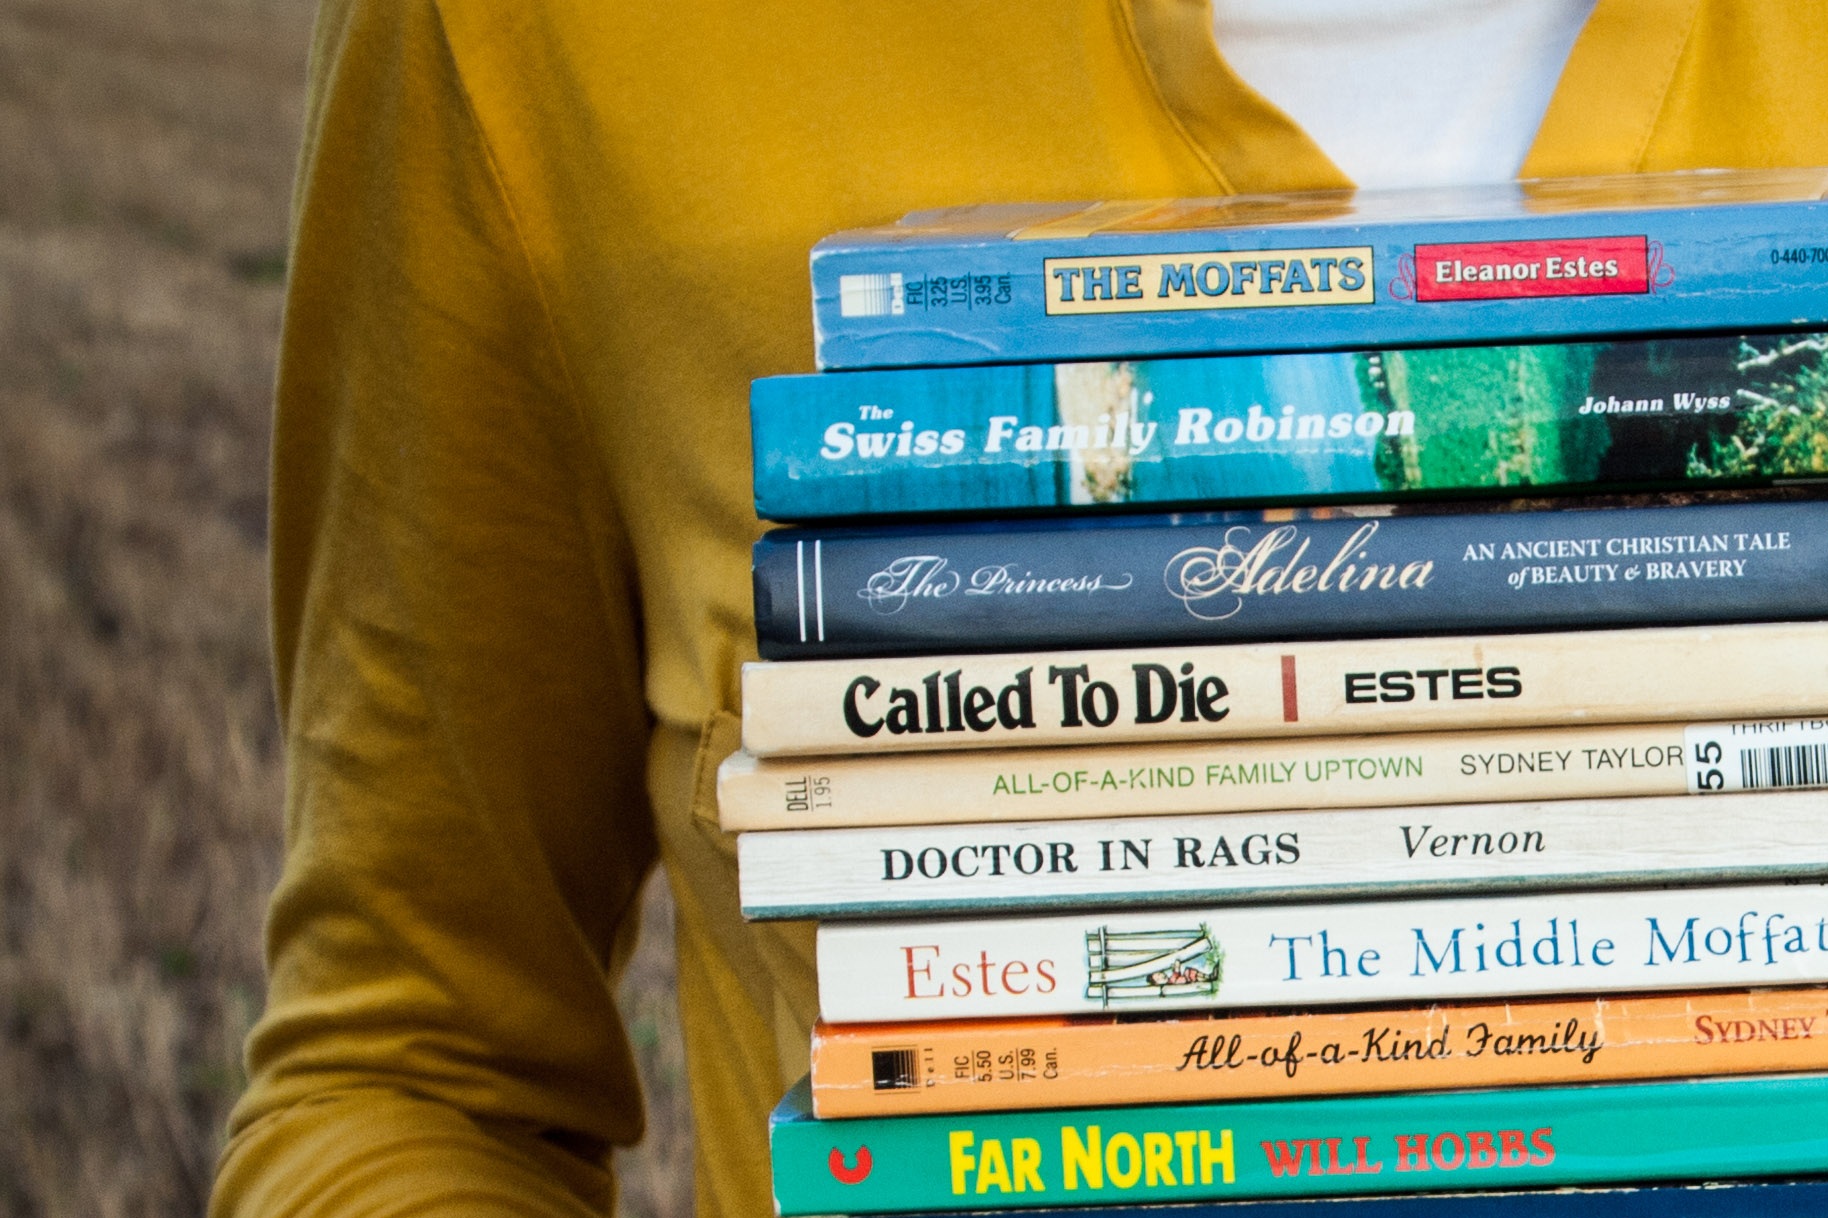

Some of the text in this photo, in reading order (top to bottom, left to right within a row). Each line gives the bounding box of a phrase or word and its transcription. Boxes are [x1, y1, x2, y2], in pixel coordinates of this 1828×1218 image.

[1054, 255, 1366, 304] THE MOFFATS
[1434, 254, 1618, 285] Eleanor Estes
[905, 281, 924, 306] FIC
[931, 276, 949, 307] 3.25
[951, 275, 968, 304] U.S.
[974, 275, 992, 306] 3.95
[994, 271, 1012, 305] Can.
[858, 404, 894, 422] The
[1578, 391, 1731, 416] Johann Wyss
[820, 403, 1416, 461] Swiss Family Robinson
[1462, 531, 1791, 562] AN ANCIENT CHRISTIAN TALE
[857, 554, 1133, 616] The Princess
[1164, 520, 1435, 620] Adelina
[1508, 558, 1747, 589] of BEAUTY & BRAVERY
[842, 660, 1230, 739] Called To Die
[1344, 665, 1523, 704] ESTES
[993, 755, 1424, 796] ALL-OF-A-KIND FAMILY UPTOWN
[1460, 744, 1684, 776] SYDNEY TAYLOR
[785, 776, 809, 811] DELL
[813, 776, 832, 808] 1.95
[880, 831, 1301, 881] DOCTOR IN RAGS
[1401, 824, 1546, 858] Vernon
[1268, 929, 1382, 982] The
[1410, 916, 1616, 978] Middle
[900, 944, 1057, 1001] Estes
[1176, 1017, 1603, 1077] All-of-a-Kind Family
[1694, 1014, 1818, 1047] SYDNEY
[954, 1055, 970, 1079] FIC
[976, 1049, 993, 1082] 5.50
[998, 1050, 1014, 1081] U.S.
[1020, 1047, 1036, 1080] 7.99
[1043, 1047, 1059, 1080] Can.
[948, 1126, 1236, 1195] FAR NORTH
[1260, 1128, 1557, 1178] WILL HOBBS
